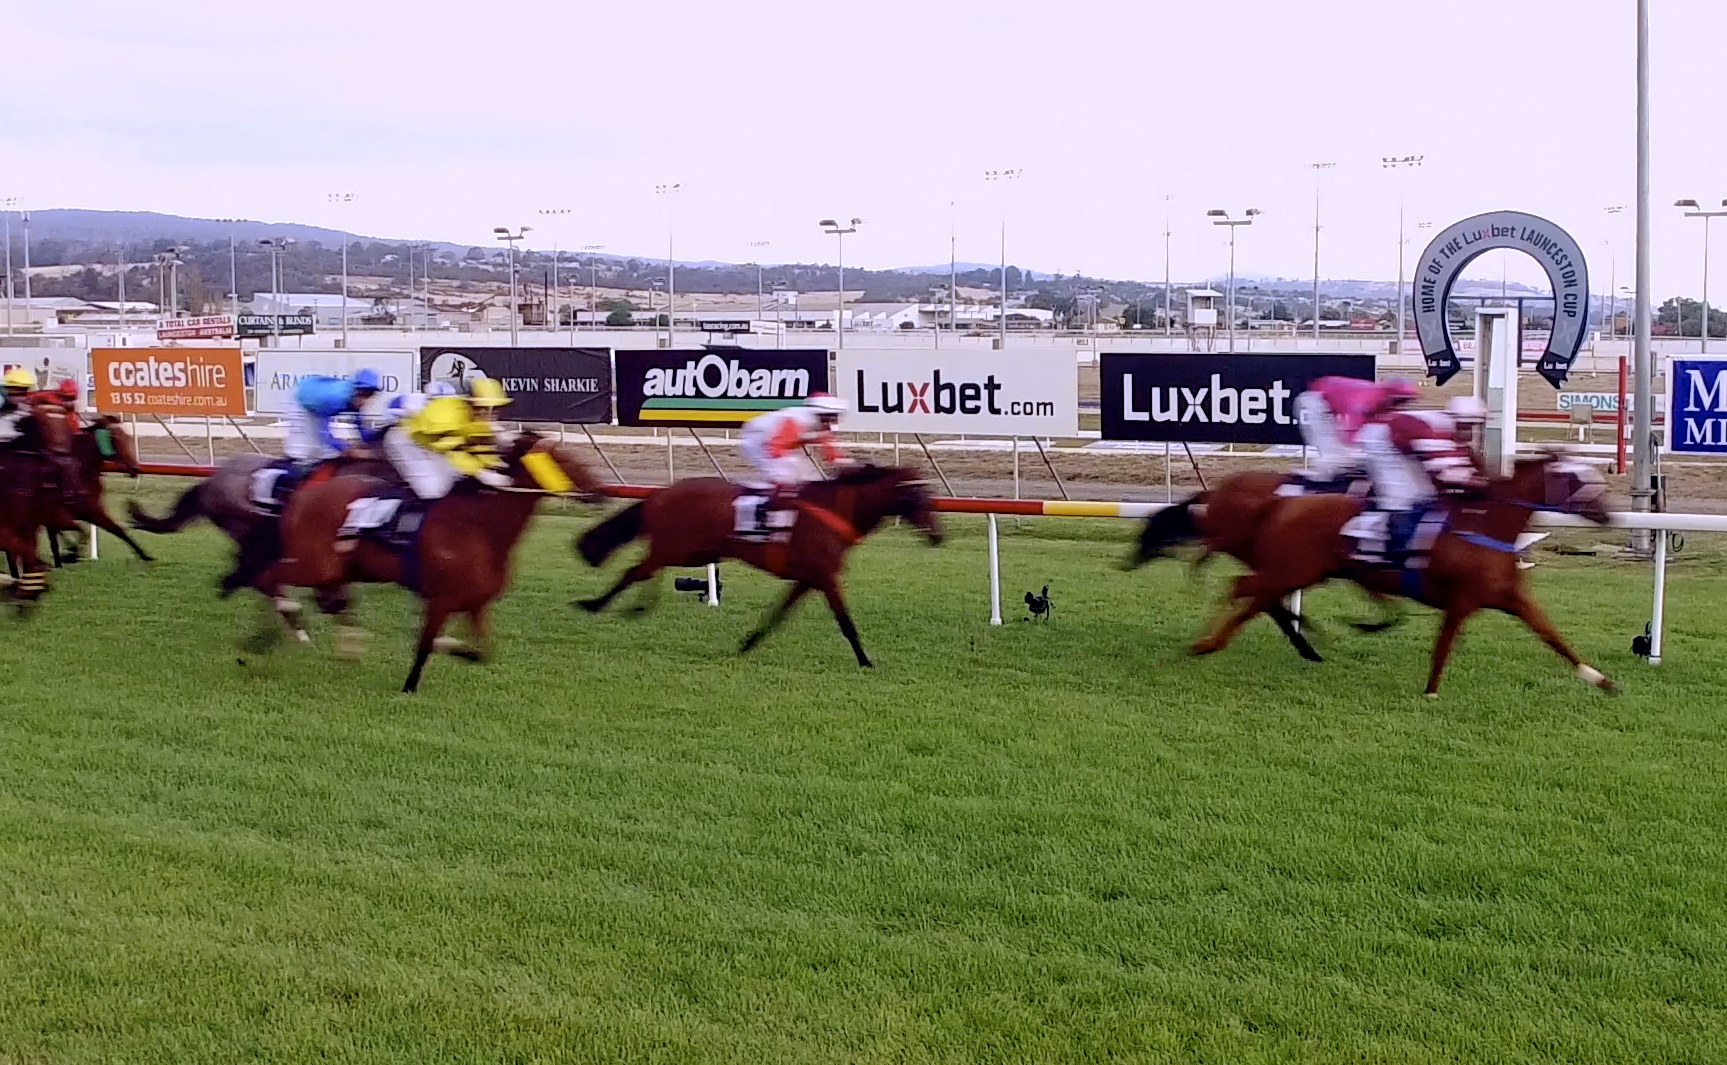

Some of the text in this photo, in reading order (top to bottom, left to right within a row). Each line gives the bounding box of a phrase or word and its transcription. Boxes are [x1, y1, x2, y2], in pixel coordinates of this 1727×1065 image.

[1421, 224, 1579, 318] HOME OF THE Luxbet LAUNCESTON CUP
[238, 316, 277, 325] CURTAIN
[502, 377, 599, 393] KEVIN SHARKIE
[110, 392, 228, 407] 13 15 52 coateshire.com.au
